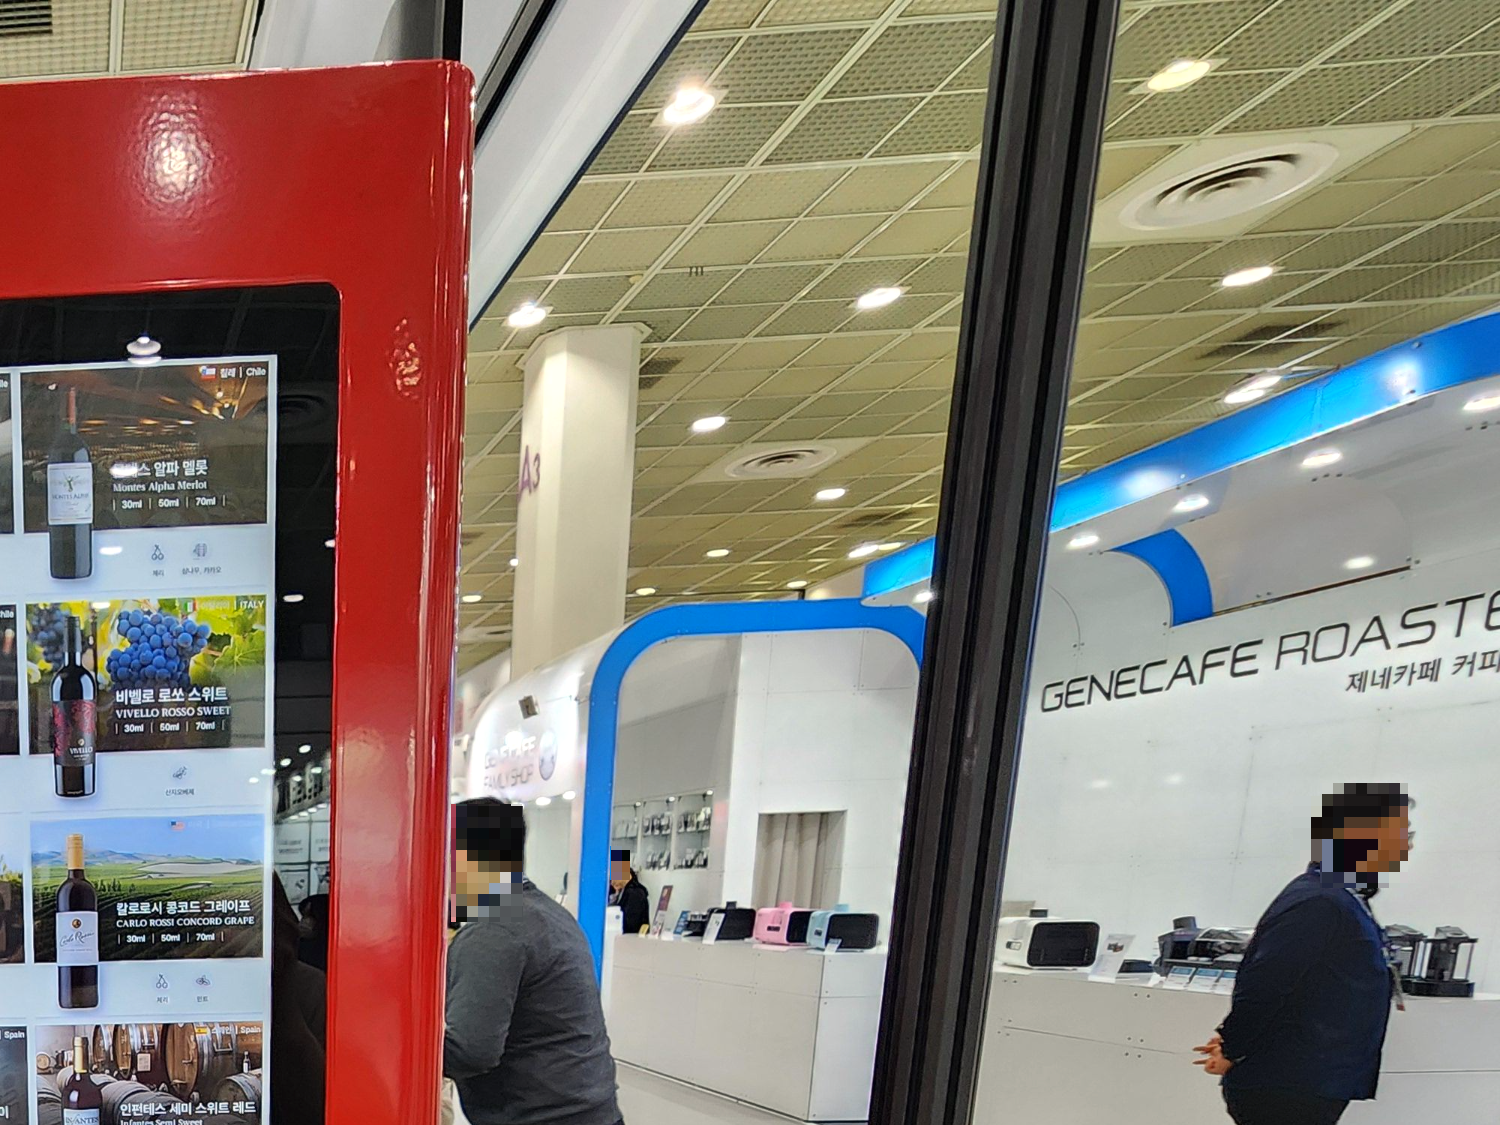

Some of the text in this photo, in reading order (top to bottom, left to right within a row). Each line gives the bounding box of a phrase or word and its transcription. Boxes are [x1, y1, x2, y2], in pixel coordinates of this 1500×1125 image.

[246, 367, 266, 376] Chile
[154, 461, 180, 477] 알파
[182, 459, 208, 476] 멜롯
[516, 445, 541, 502] A3
[113, 480, 207, 493] Montes Alpha Merlot
[121, 500, 143, 509] 30ml
[195, 497, 216, 506] 70ml
[240, 600, 264, 609] ITALY
[1040, 638, 1265, 713] GENECAFE
[1345, 649, 1500, 693] 제네카페 커피
[115, 686, 228, 705] 비벨로 로쏘 스위트
[115, 705, 231, 719] VIVELLO ROSSO SWEET
[123, 723, 144, 733] 30ml
[195, 721, 216, 731] 70ml
[116, 899, 251, 916] 칼로로시 콩코드 그레이프
[116, 915, 255, 928] CARLO ROSSI CONCORD GRAPE
[126, 934, 146, 943] 30ml
[195, 932, 215, 941] 70ml
[4, 1030, 25, 1040] Spain
[240, 1026, 262, 1035] Spain
[169, 1102, 192, 1116] 세미
[195, 1101, 230, 1115] 스위트
[232, 1101, 257, 1114] 레드
